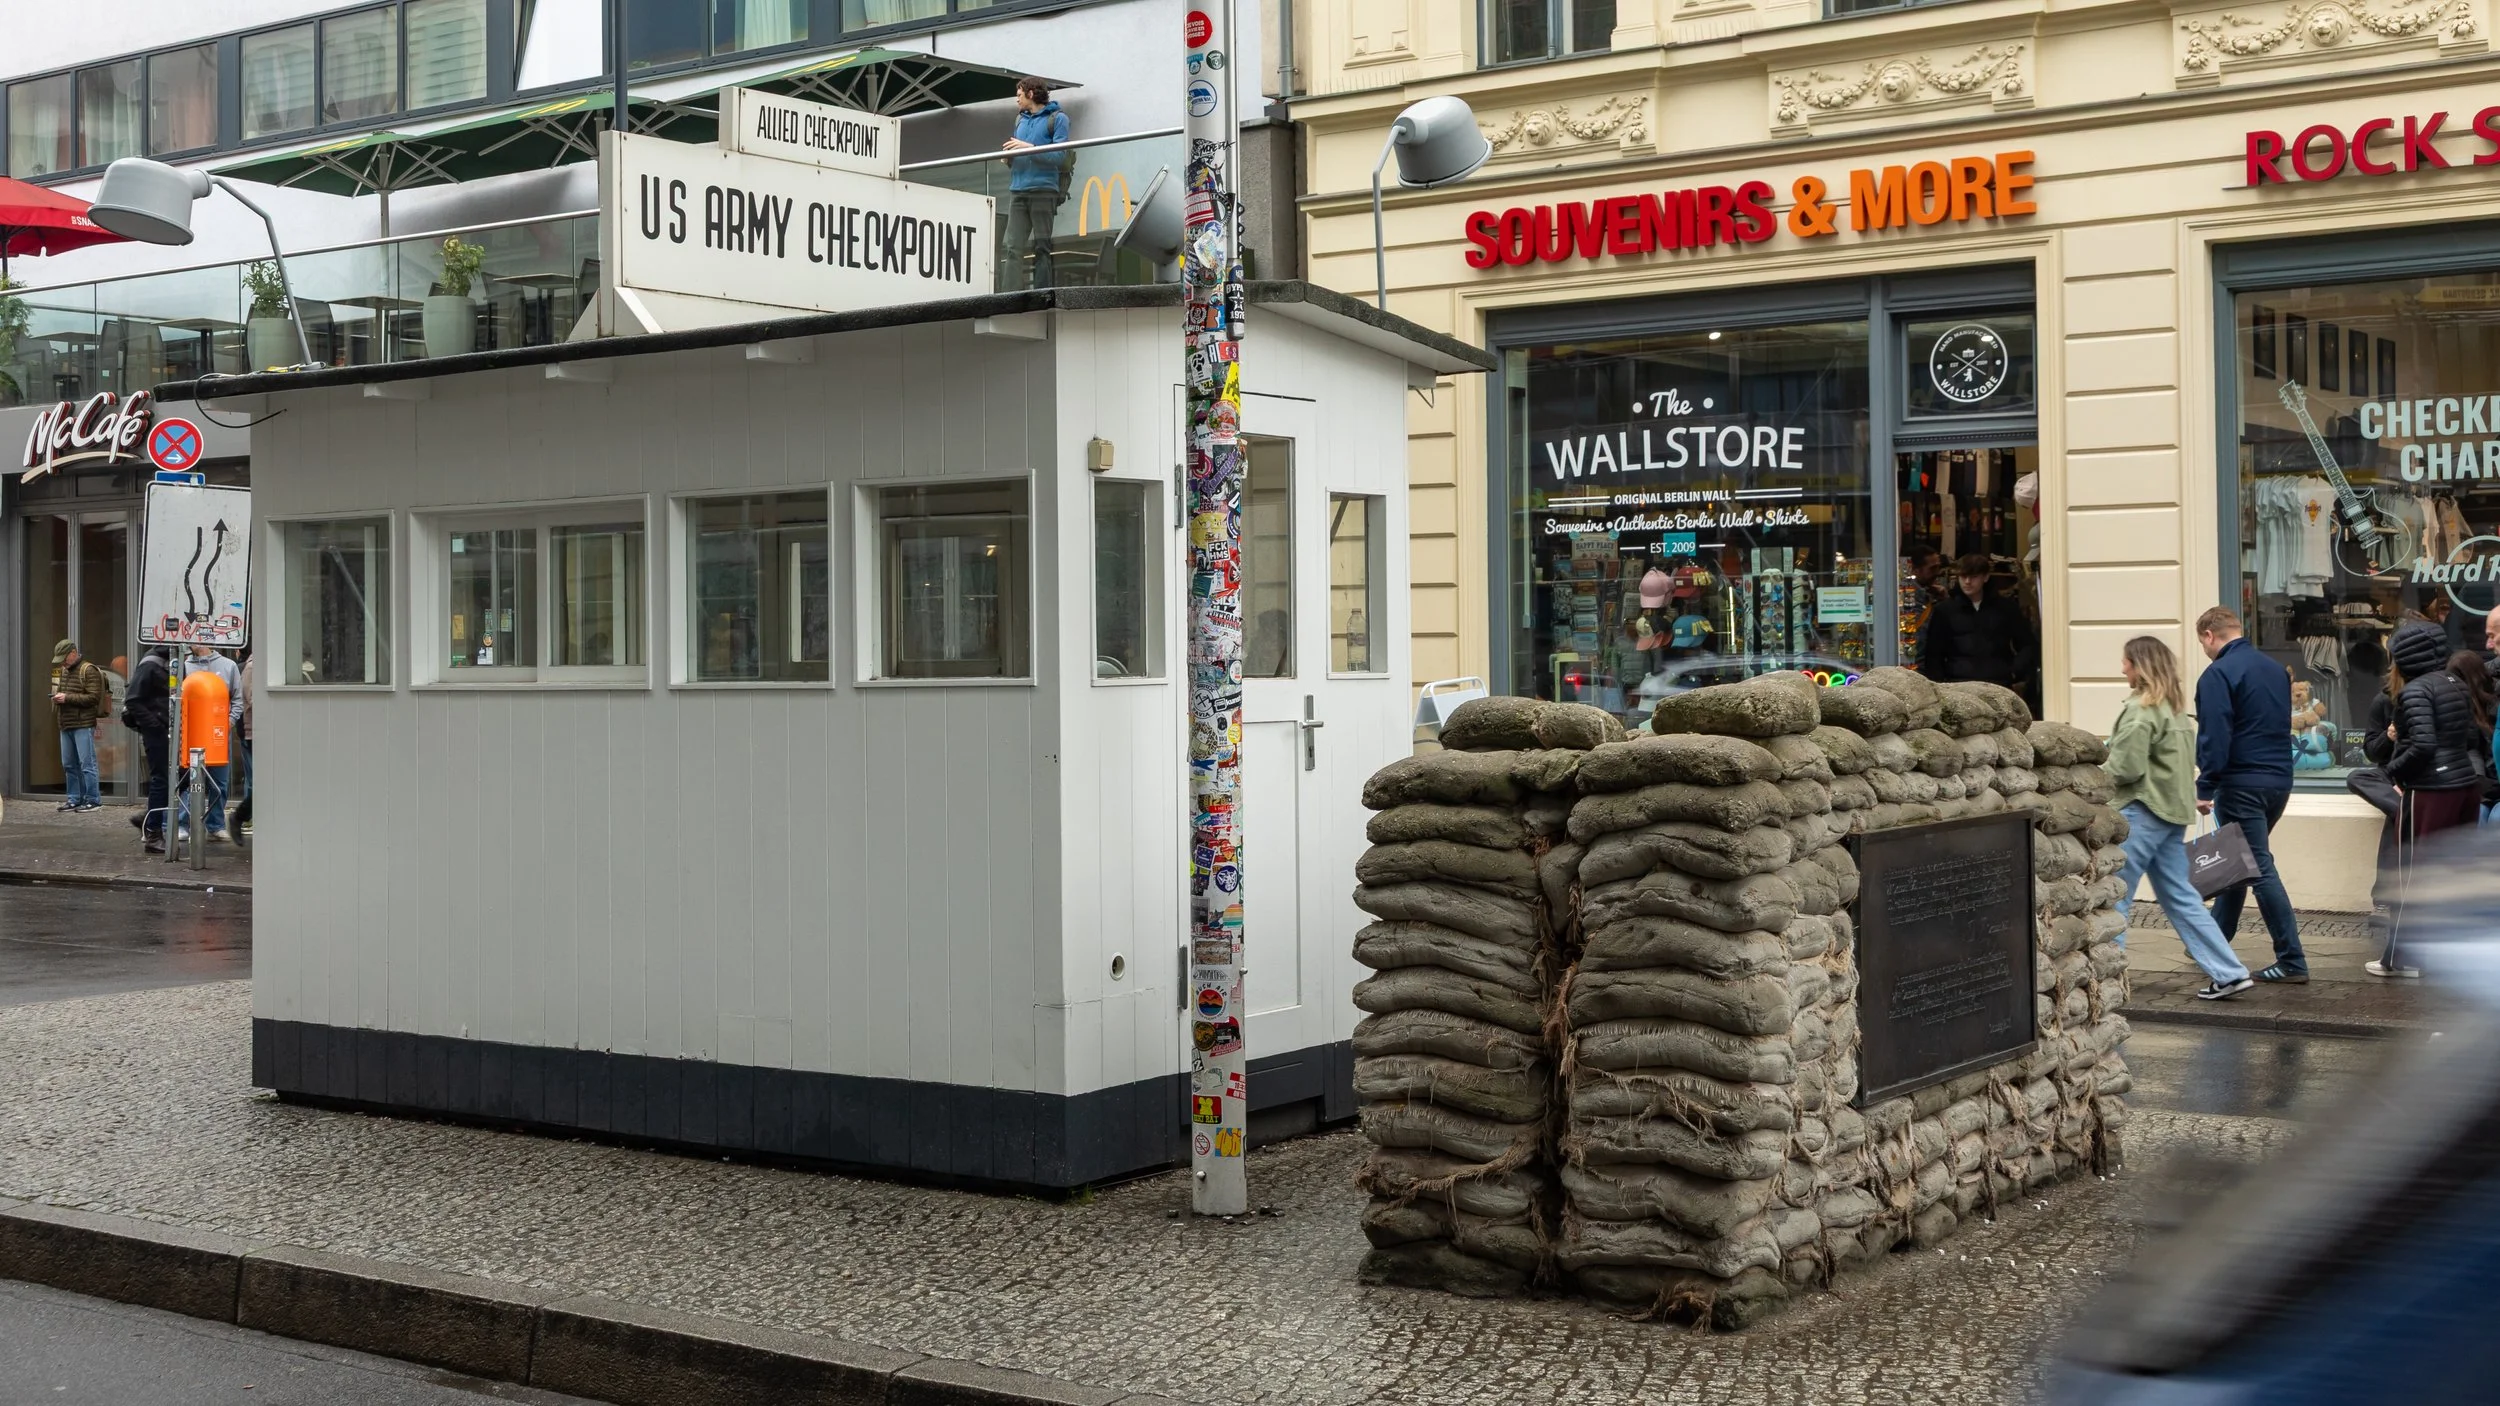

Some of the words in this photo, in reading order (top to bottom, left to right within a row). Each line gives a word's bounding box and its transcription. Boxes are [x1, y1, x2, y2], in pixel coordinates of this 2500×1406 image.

[757, 105, 798, 144] ALLIED
[804, 115, 880, 159] CHECKPOINT
[2246, 111, 2449, 186] ROCK
[1464, 181, 1776, 270] SOUVENIRS
[1788, 175, 1839, 239] &
[1850, 150, 2037, 231] MORE
[641, 174, 687, 244] US
[705, 185, 793, 259] ARMY
[808, 202, 977, 285] CHECKPOINT
[1940, 375, 1999, 398] WALLSTORE
[1650, 388, 1693, 418] The
[23, 390, 149, 474] McCafé
[1545, 425, 1805, 480] WALLSTORE
[1614, 492, 1662, 505] ORIGINAL
[1664, 490, 1701, 503] BERLIN
[1702, 489, 1731, 501] WALL
[1545, 518, 1605, 535] Souvenirs
[1614, 513, 1674, 533] Authentic
[1675, 511, 1717, 531] Berlin
[1720, 509, 1753, 527] Wall
[1764, 507, 1810, 527] Shirts
[1208, 541, 1228, 551] FCK
[1209, 550, 1229, 560] HMS
[1650, 543, 1670, 554] EST.
[1672, 541, 1696, 553] 2009
[2411, 554, 2485, 583] Hard
